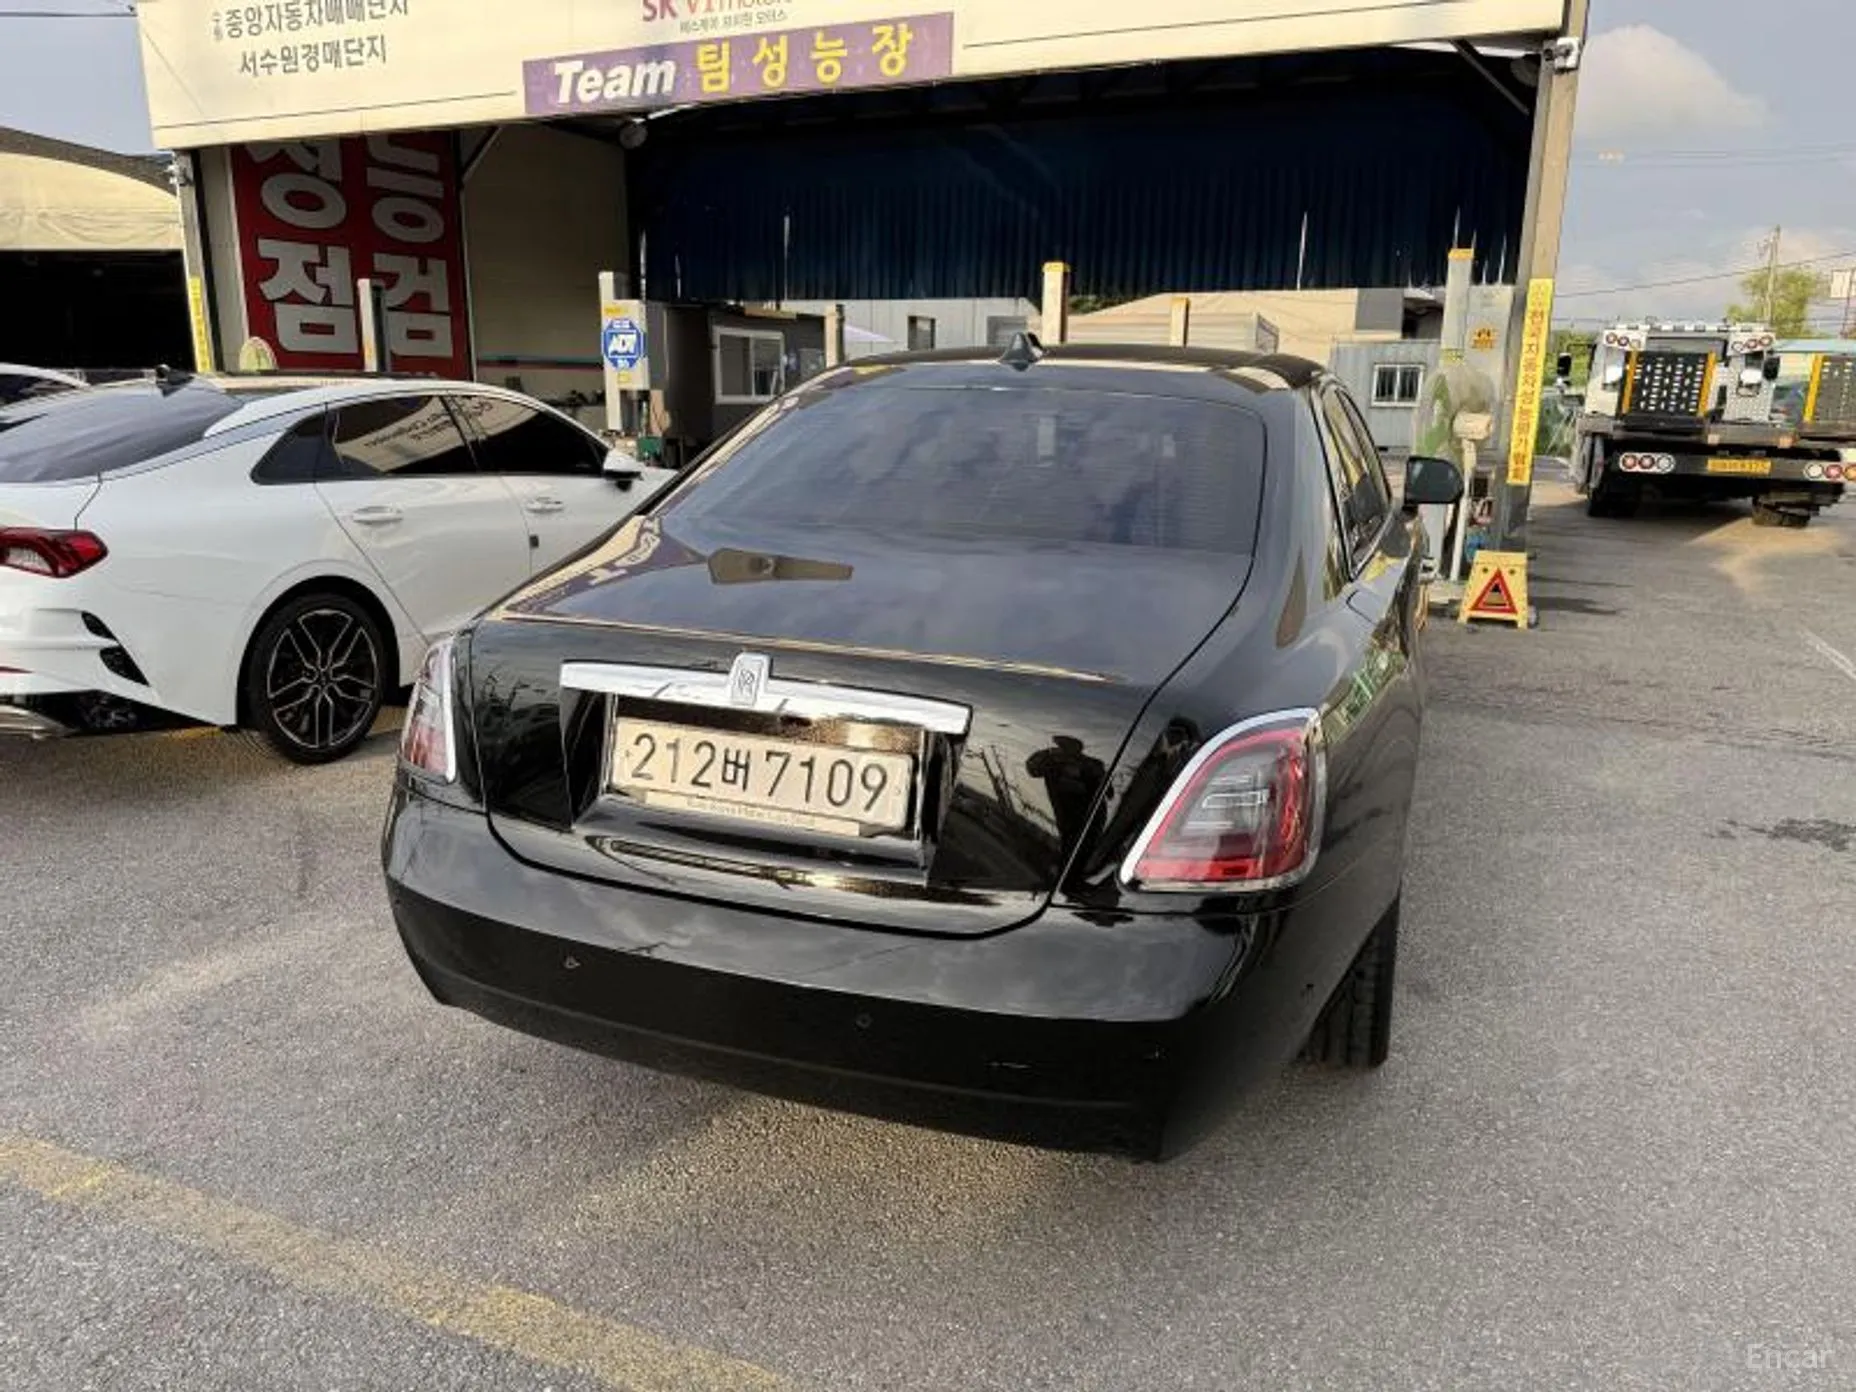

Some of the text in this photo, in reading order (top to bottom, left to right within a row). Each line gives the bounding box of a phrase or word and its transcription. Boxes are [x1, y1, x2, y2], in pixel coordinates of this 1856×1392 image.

[240, 34, 387, 77] 서수원경매단지
[555, 59, 676, 103] Team
[631, 733, 889, 812] 212버 7109
